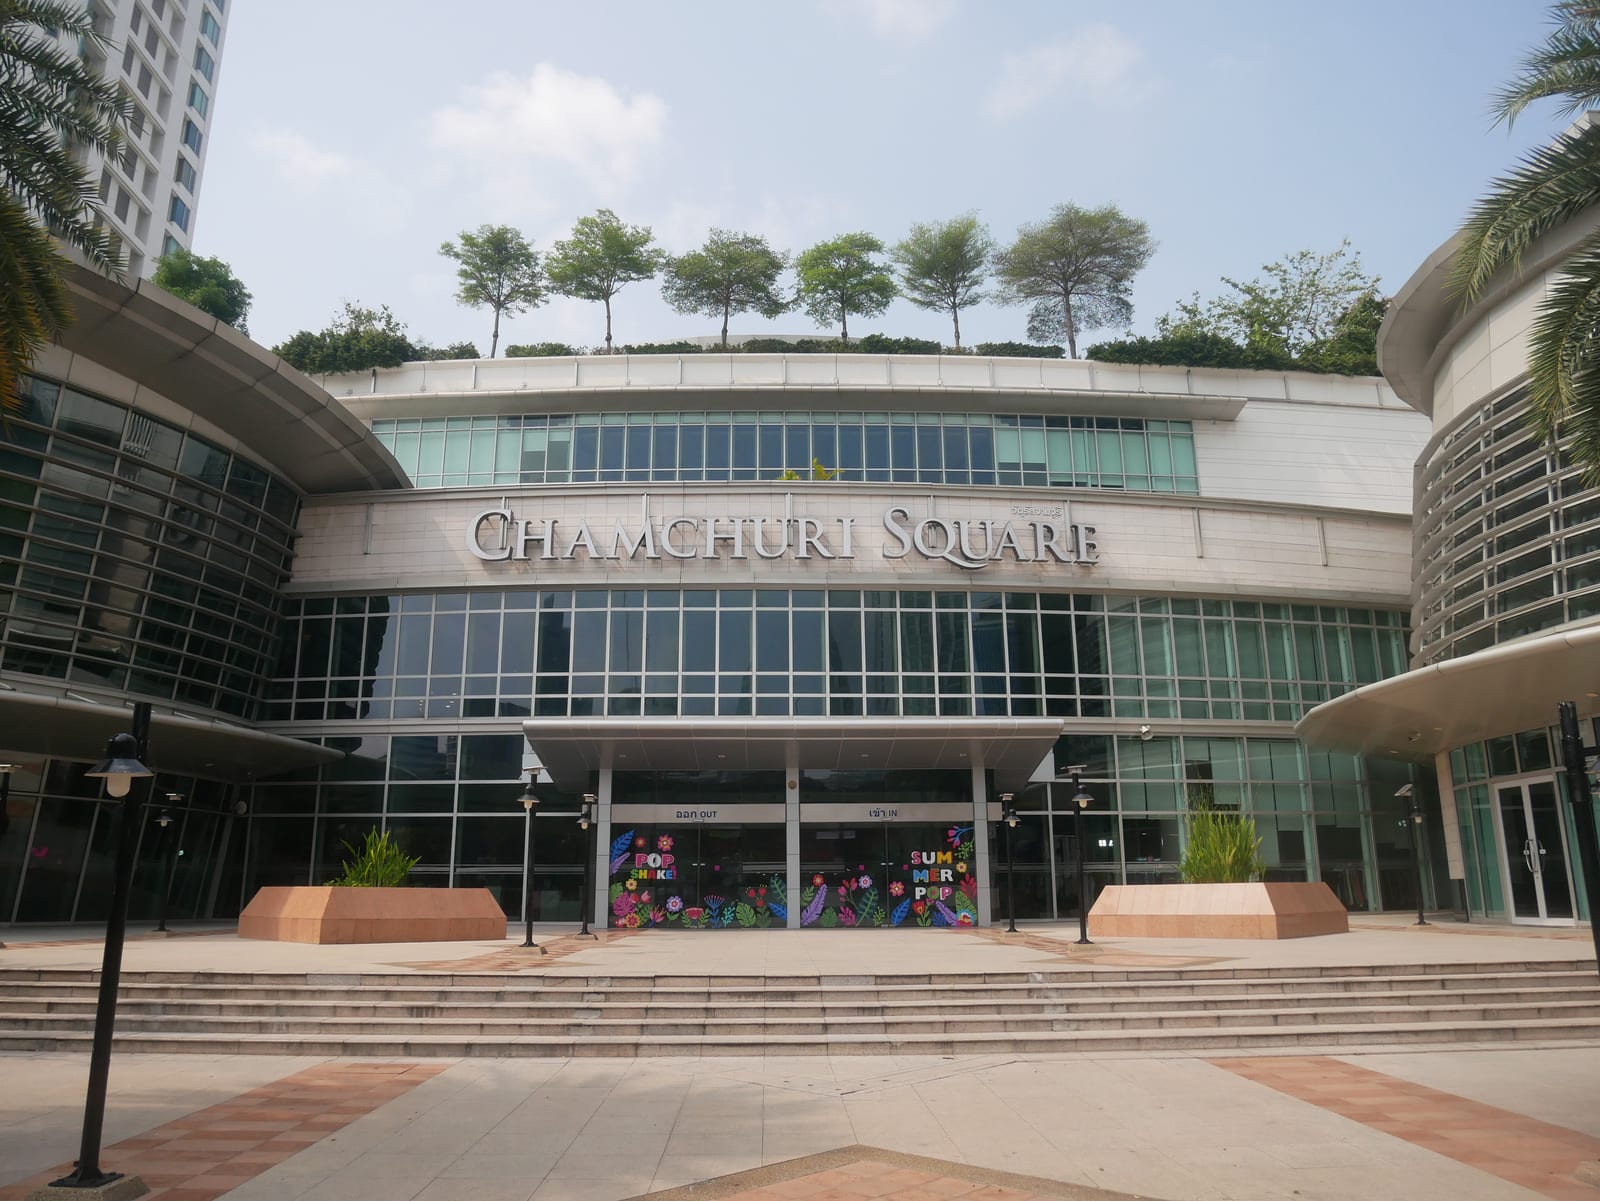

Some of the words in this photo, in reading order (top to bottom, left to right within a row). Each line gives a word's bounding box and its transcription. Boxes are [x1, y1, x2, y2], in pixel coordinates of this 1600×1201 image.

[466, 507, 856, 562] CHAMCHURI
[882, 505, 1099, 570] SQUARE
[869, 807, 886, 817] เข้า
[635, 853, 675, 868] POP
[911, 851, 953, 865] SUM
[631, 866, 677, 880] SHAKE!
[913, 869, 954, 883] MER
[915, 887, 953, 900] POP
